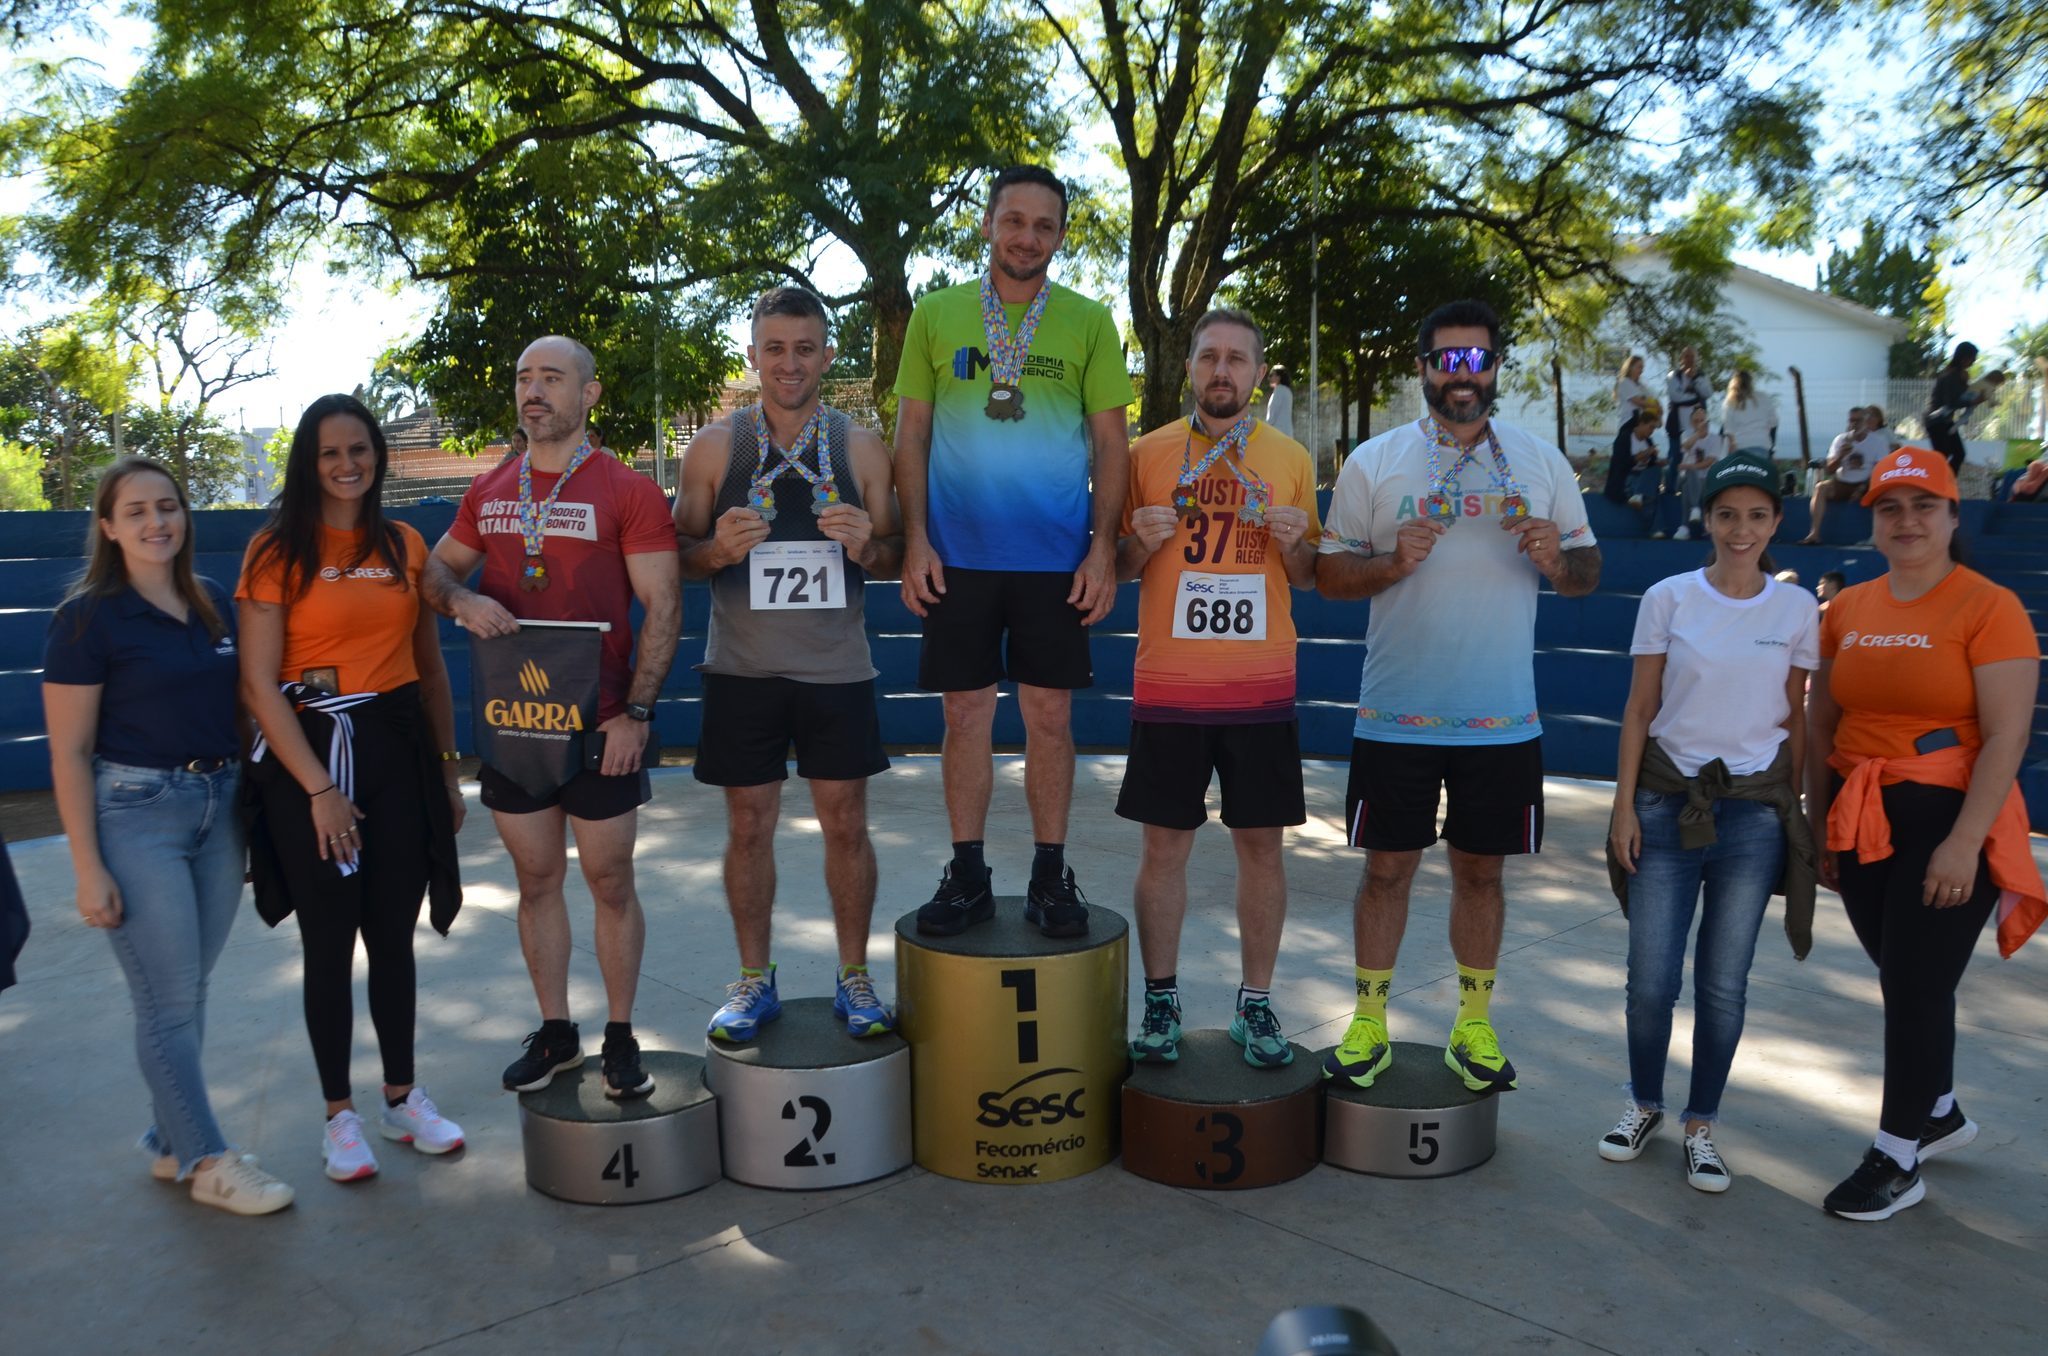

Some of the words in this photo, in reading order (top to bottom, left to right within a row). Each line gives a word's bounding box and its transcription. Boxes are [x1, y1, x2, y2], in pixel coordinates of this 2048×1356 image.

[1021, 366, 1065, 381] RENCIO
[1026, 354, 1065, 368] DEMIA
[1880, 467, 1929, 481] CRESOL
[480, 497, 538, 518] RÚSTIA
[549, 507, 588, 519] RODEIO
[546, 518, 586, 532] BONITO
[1184, 511, 1235, 565] 37
[763, 565, 829, 604] 721
[1185, 581, 1215, 594] Sesc
[1186, 597, 1254, 635] 688
[1859, 633, 1935, 649] CRESOL
[484, 699, 584, 731] GARRA
[497, 729, 519, 737] centro
[1001, 968, 1038, 1064] 1
[975, 1086, 1086, 1128] Sesc
[782, 1095, 836, 1167] 2
[975, 1134, 1086, 1159] Fecomércio
[1194, 1111, 1246, 1185] 3
[1408, 1122, 1440, 1166] 5
[601, 1143, 640, 1188] 4
[976, 1162, 1038, 1179] Senac
